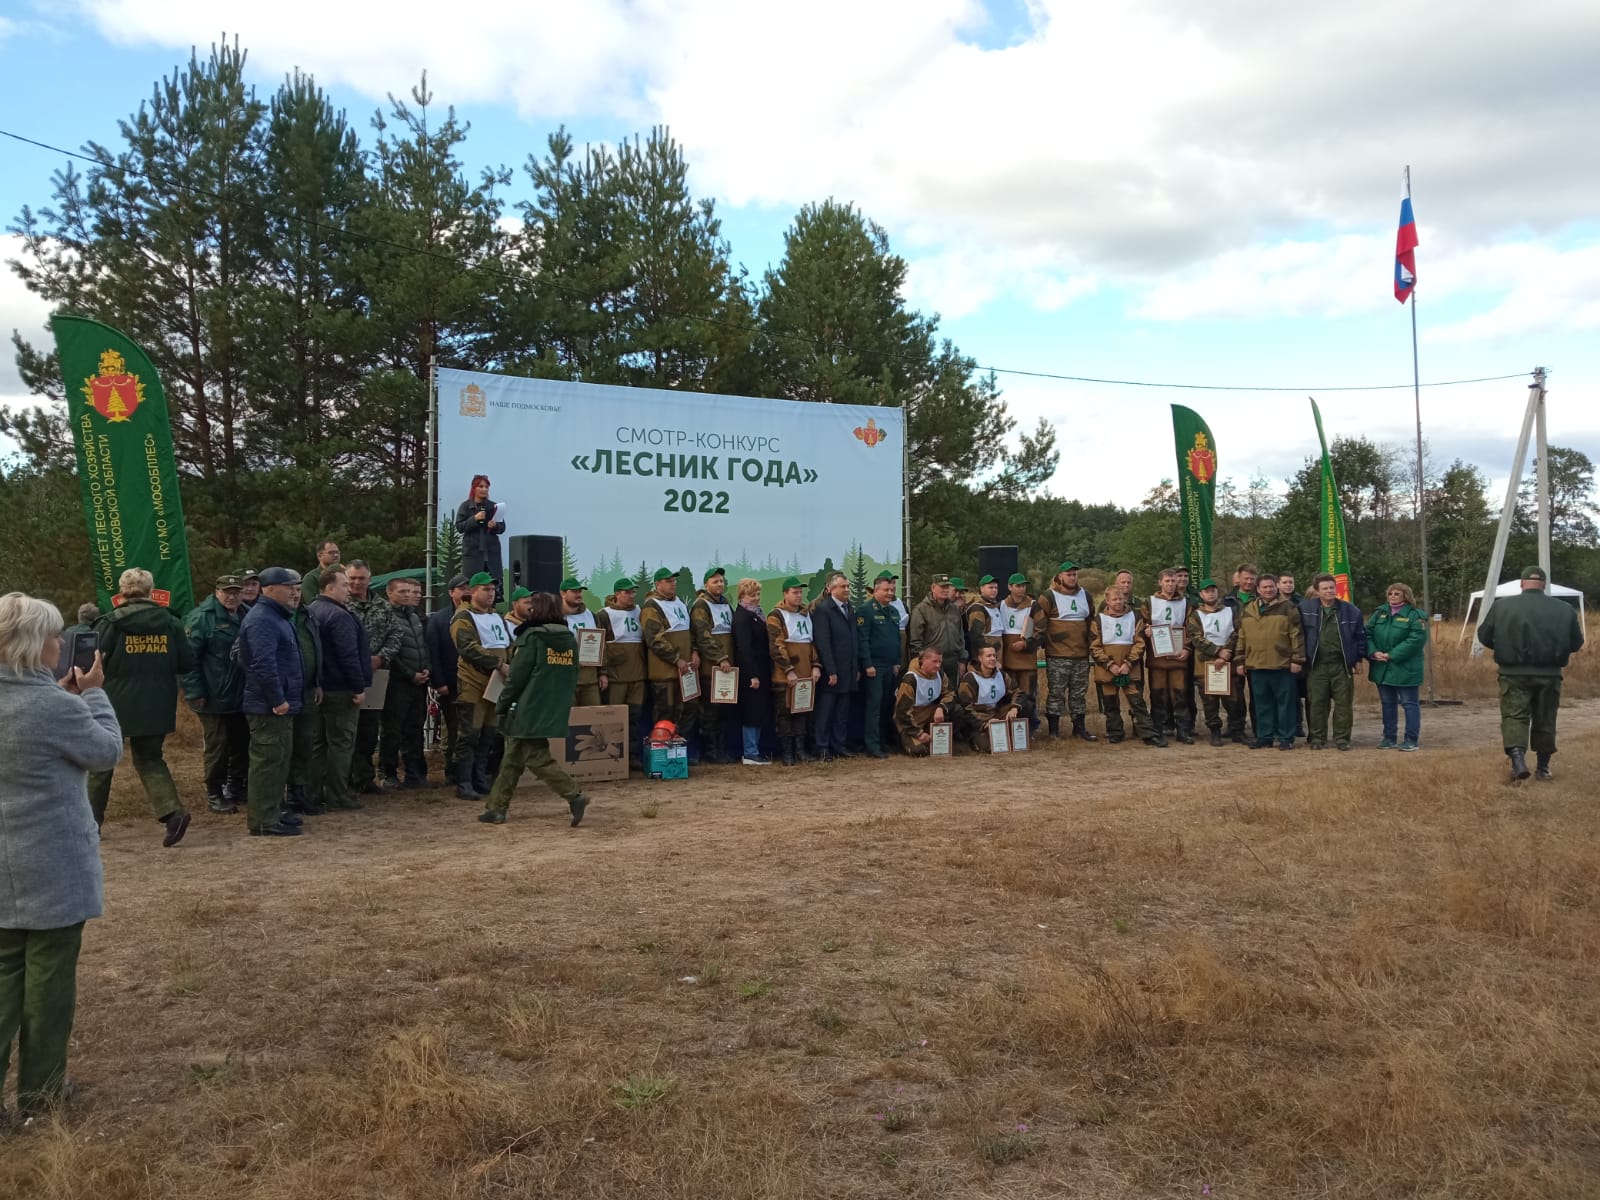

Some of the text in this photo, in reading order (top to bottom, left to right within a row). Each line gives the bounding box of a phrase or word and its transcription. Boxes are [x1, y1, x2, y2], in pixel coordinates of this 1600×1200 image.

[616, 426, 780, 453] СМОТР-КОНКУРС
[571, 448, 818, 488] «ЛЕСНИК ГОДА»
[81, 413, 115, 591] КОМИТЕТ ЛЕСНОГО ХОЗЯЙСТВА
[98, 434, 126, 567] МОСКОВСКОЙ ОБЛАСТИ
[144, 433, 171, 560] ГКУ МО «МОСОБЛЛЕС»
[664, 488, 730, 514] 2022
[1190, 524, 1198, 562] ЛЕСНОГО
[1070, 599, 1077, 612] 4
[1008, 614, 1015, 629] 6
[1165, 607, 1172, 621] 2
[491, 623, 505, 641] 12
[624, 616, 639, 633] 15
[1115, 623, 1123, 637] 3
[1214, 619, 1220, 633] 1
[125, 635, 168, 645] ЛЕСНАЯ
[125, 644, 168, 654] ОХРАНА
[927, 687, 934, 701] 9
[990, 685, 996, 699] 5
